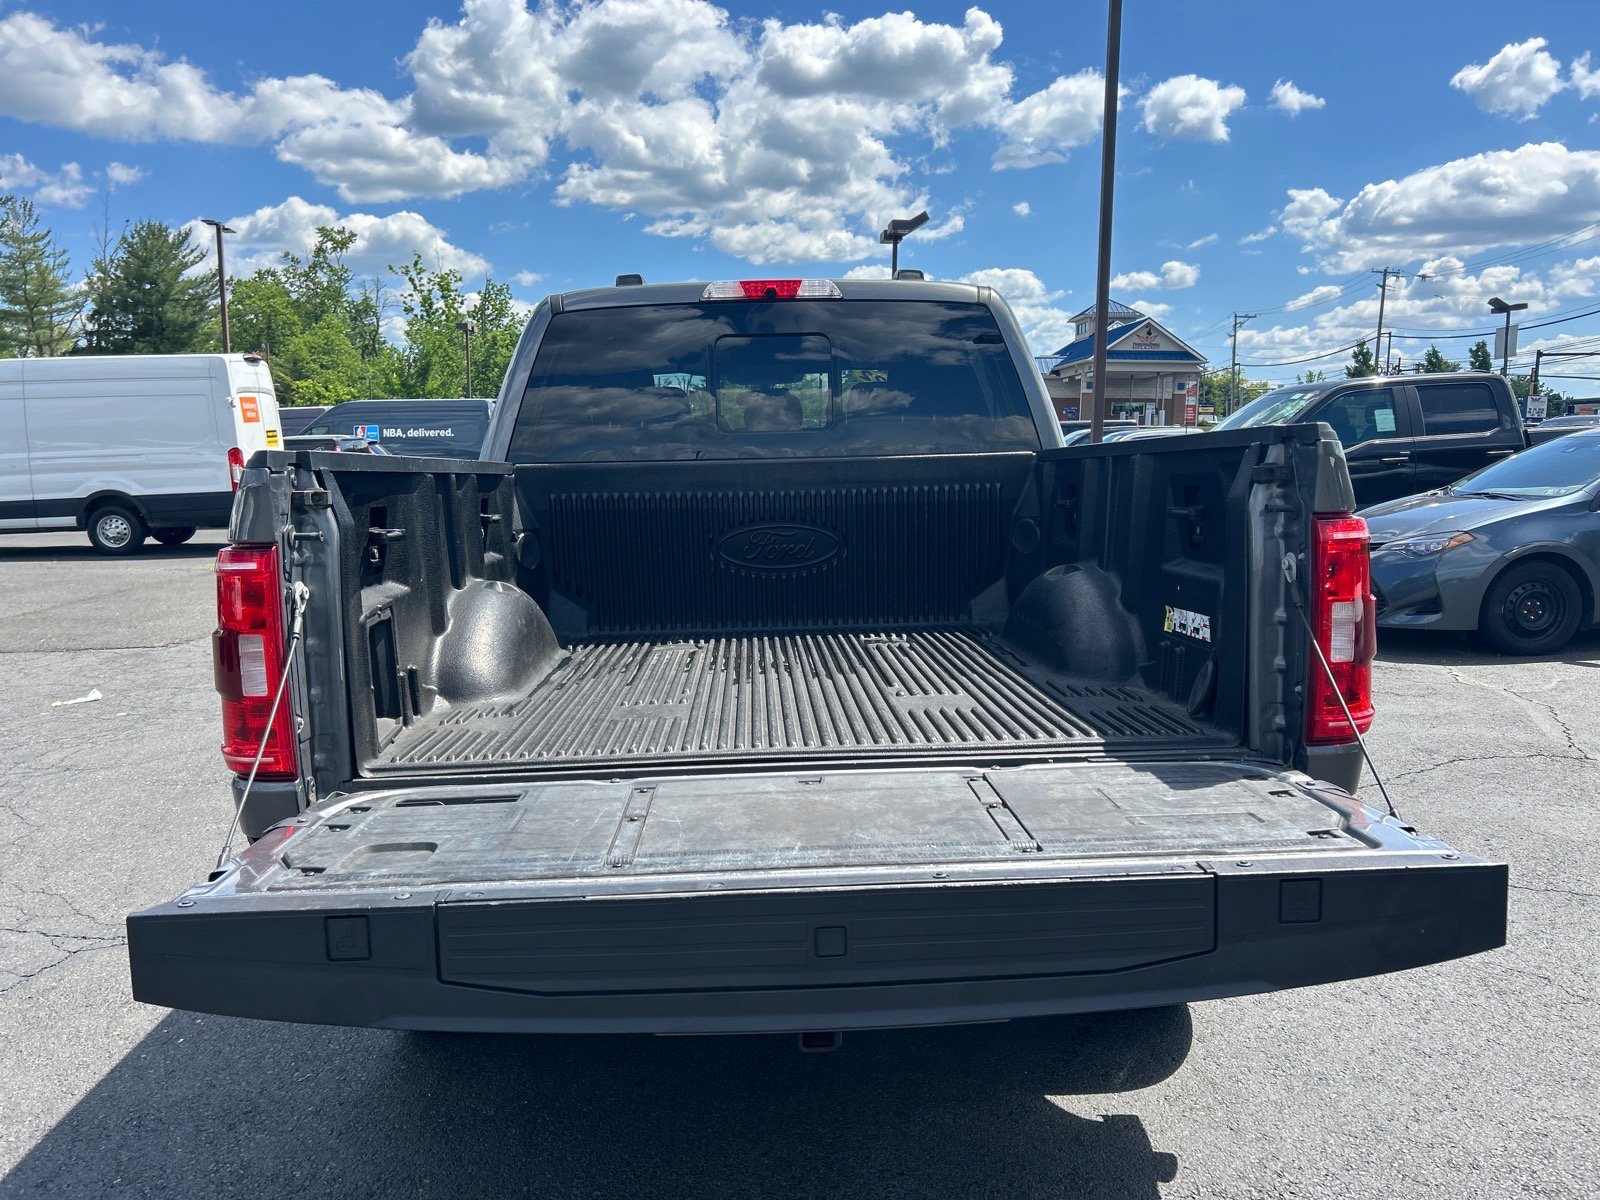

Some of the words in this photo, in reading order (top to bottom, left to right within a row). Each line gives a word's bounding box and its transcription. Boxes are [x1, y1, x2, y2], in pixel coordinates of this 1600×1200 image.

[383, 428, 405, 438] NBA,
[407, 427, 455, 437] delivered.
[743, 530, 816, 560] Ford
